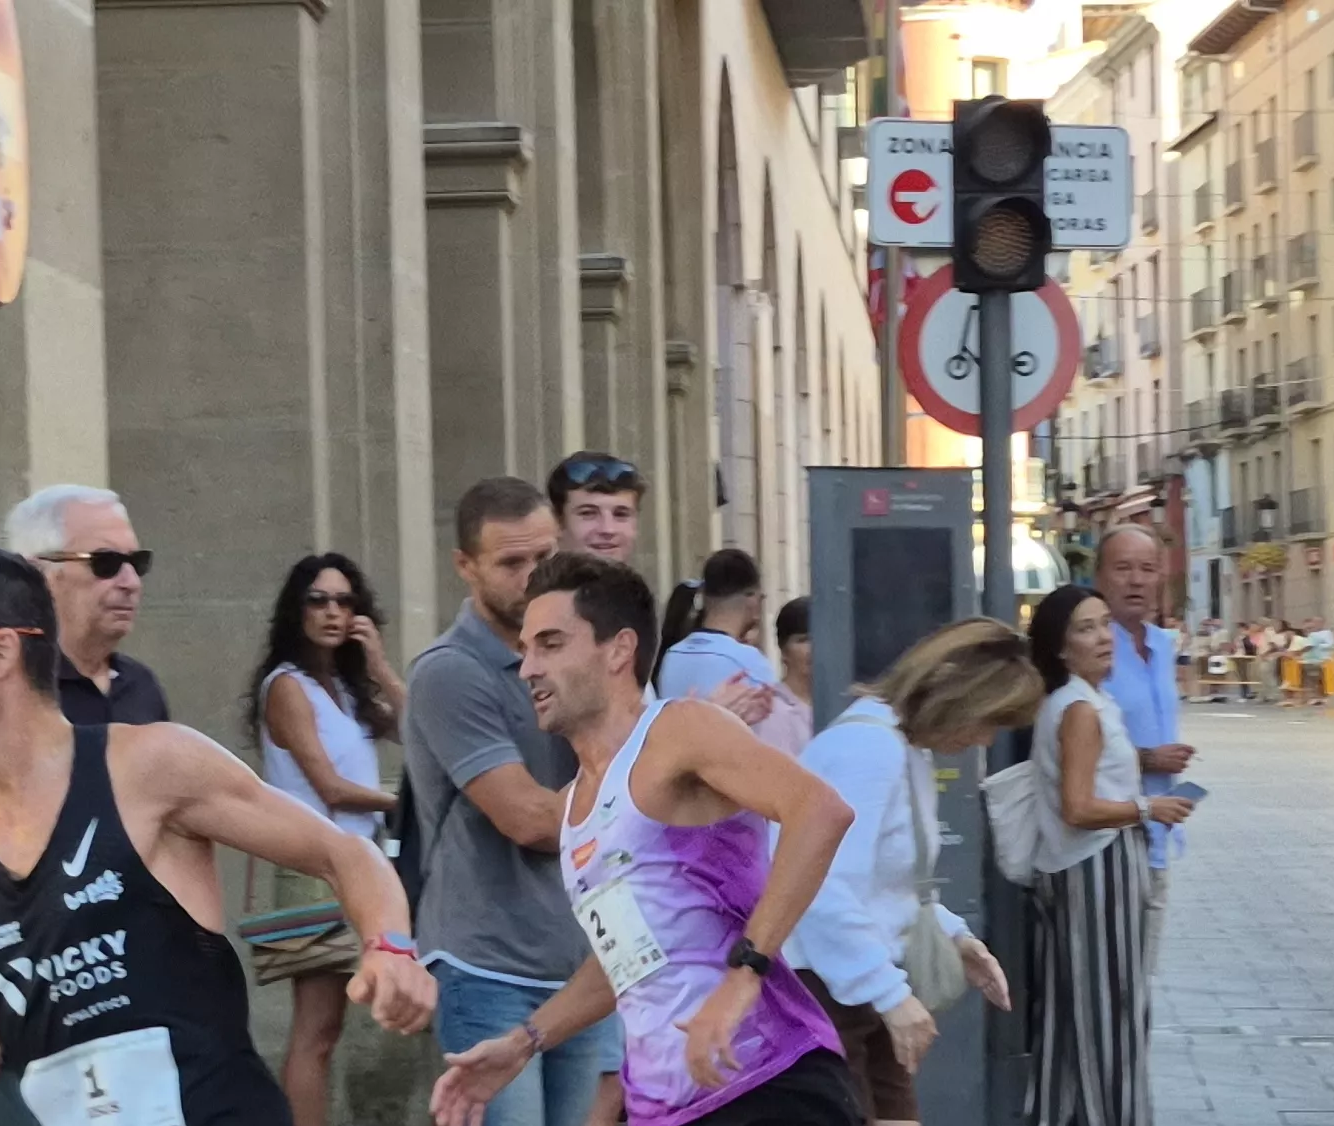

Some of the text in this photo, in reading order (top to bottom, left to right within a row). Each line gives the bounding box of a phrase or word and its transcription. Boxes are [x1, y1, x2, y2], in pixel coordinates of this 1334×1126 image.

[887, 136, 953, 154] ZONA
[589, 909, 607, 938] 2
[49, 960, 128, 1003] FOODS
[84, 1063, 106, 1098] 1
